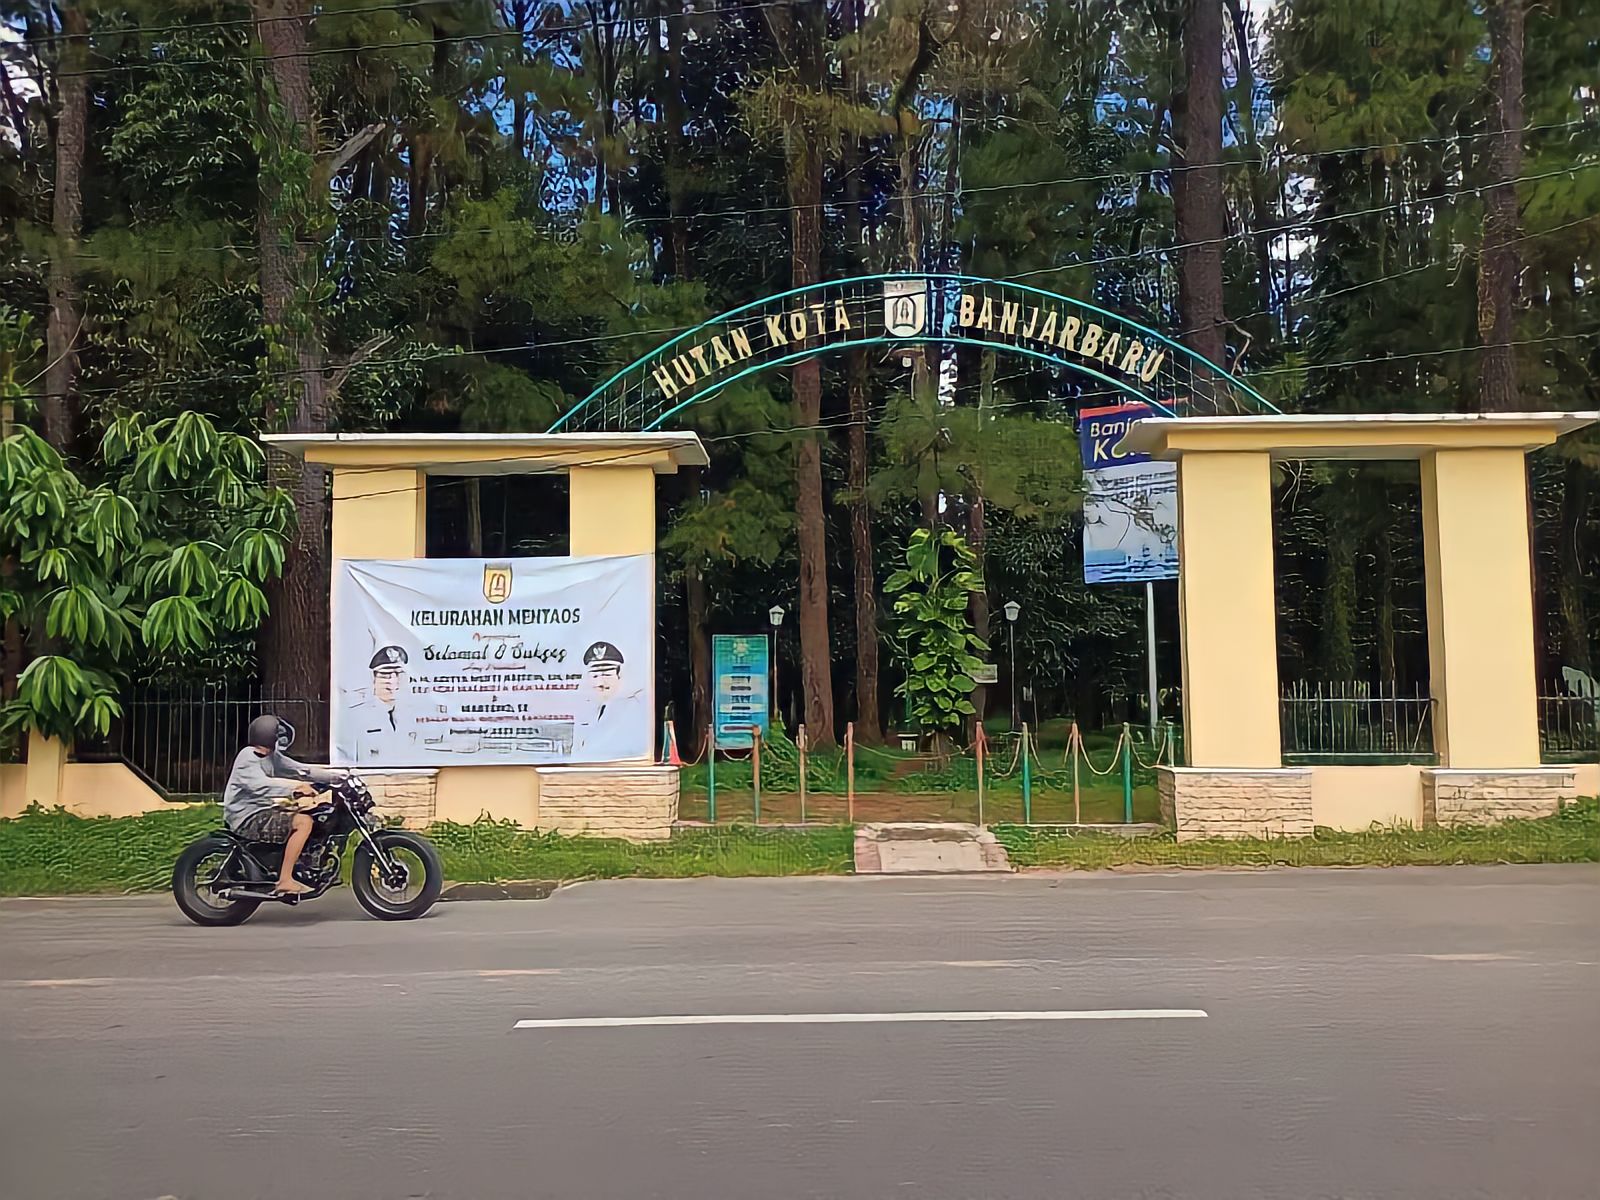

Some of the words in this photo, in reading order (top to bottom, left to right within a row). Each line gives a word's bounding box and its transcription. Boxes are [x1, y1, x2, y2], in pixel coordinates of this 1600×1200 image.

[652, 327, 752, 399] HUTAN
[767, 299, 850, 346] KOTA
[959, 294, 1166, 382] BANJARBARU
[411, 608, 503, 626] KELURAHAN
[508, 608, 580, 625] MENTAOS
